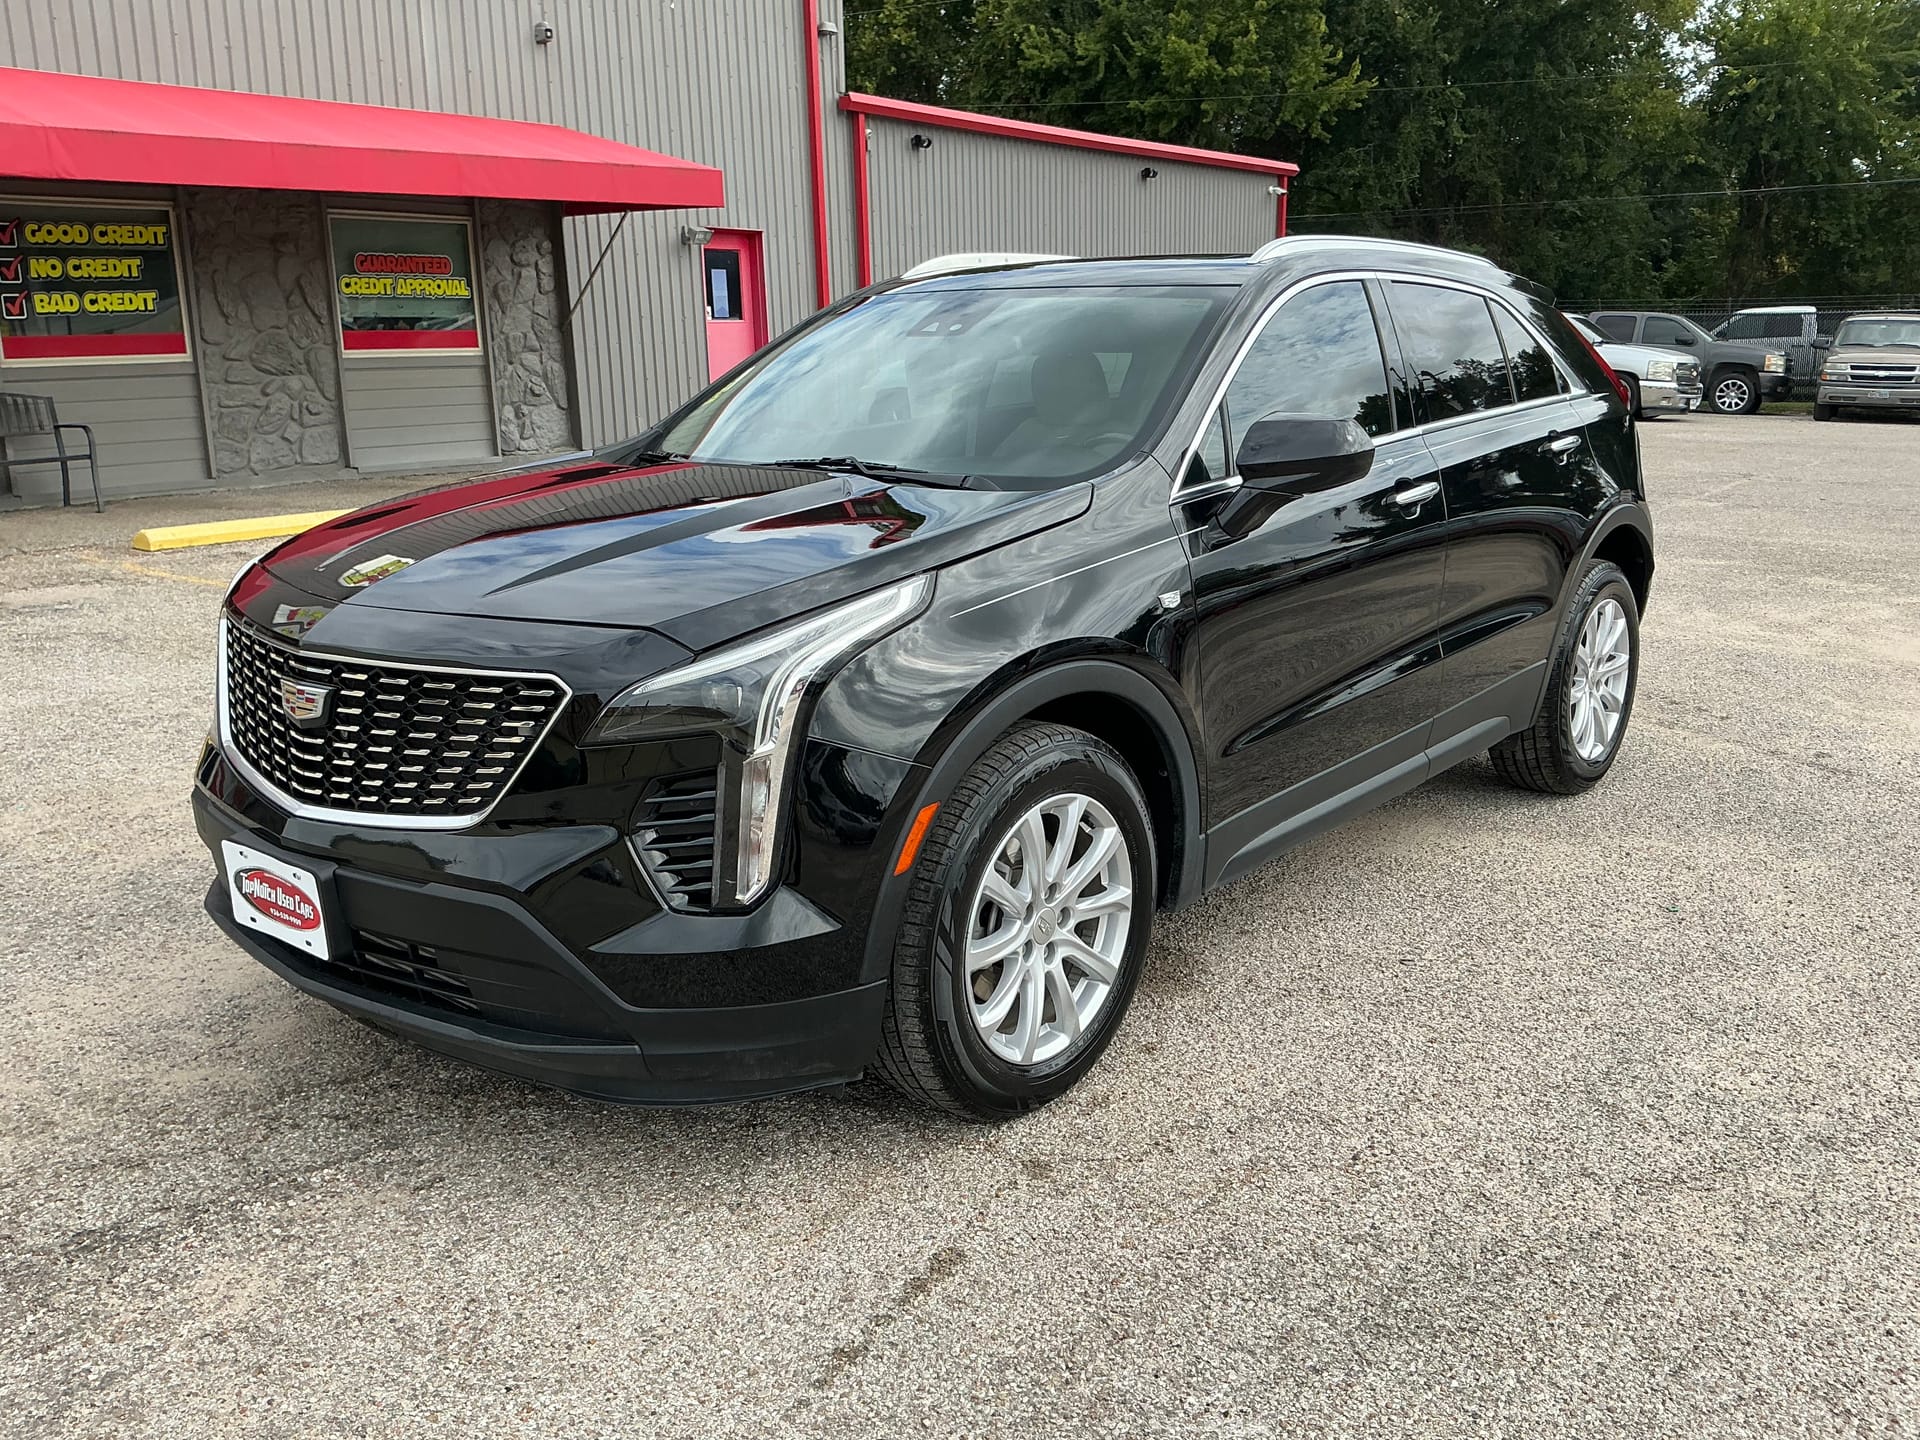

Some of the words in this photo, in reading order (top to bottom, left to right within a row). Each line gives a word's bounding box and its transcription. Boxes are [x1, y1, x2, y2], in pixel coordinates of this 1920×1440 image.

[24, 222, 90, 245] GOOD
[93, 225, 167, 246] CREDIT
[29, 257, 64, 279] NO
[66, 257, 142, 279] CREDIT
[355, 253, 451, 274] GUARANTEED
[340, 276, 394, 296] CREDIT
[395, 276, 470, 297] APPROVAL
[33, 292, 80, 314] BAD
[83, 291, 157, 313] CREDIT
